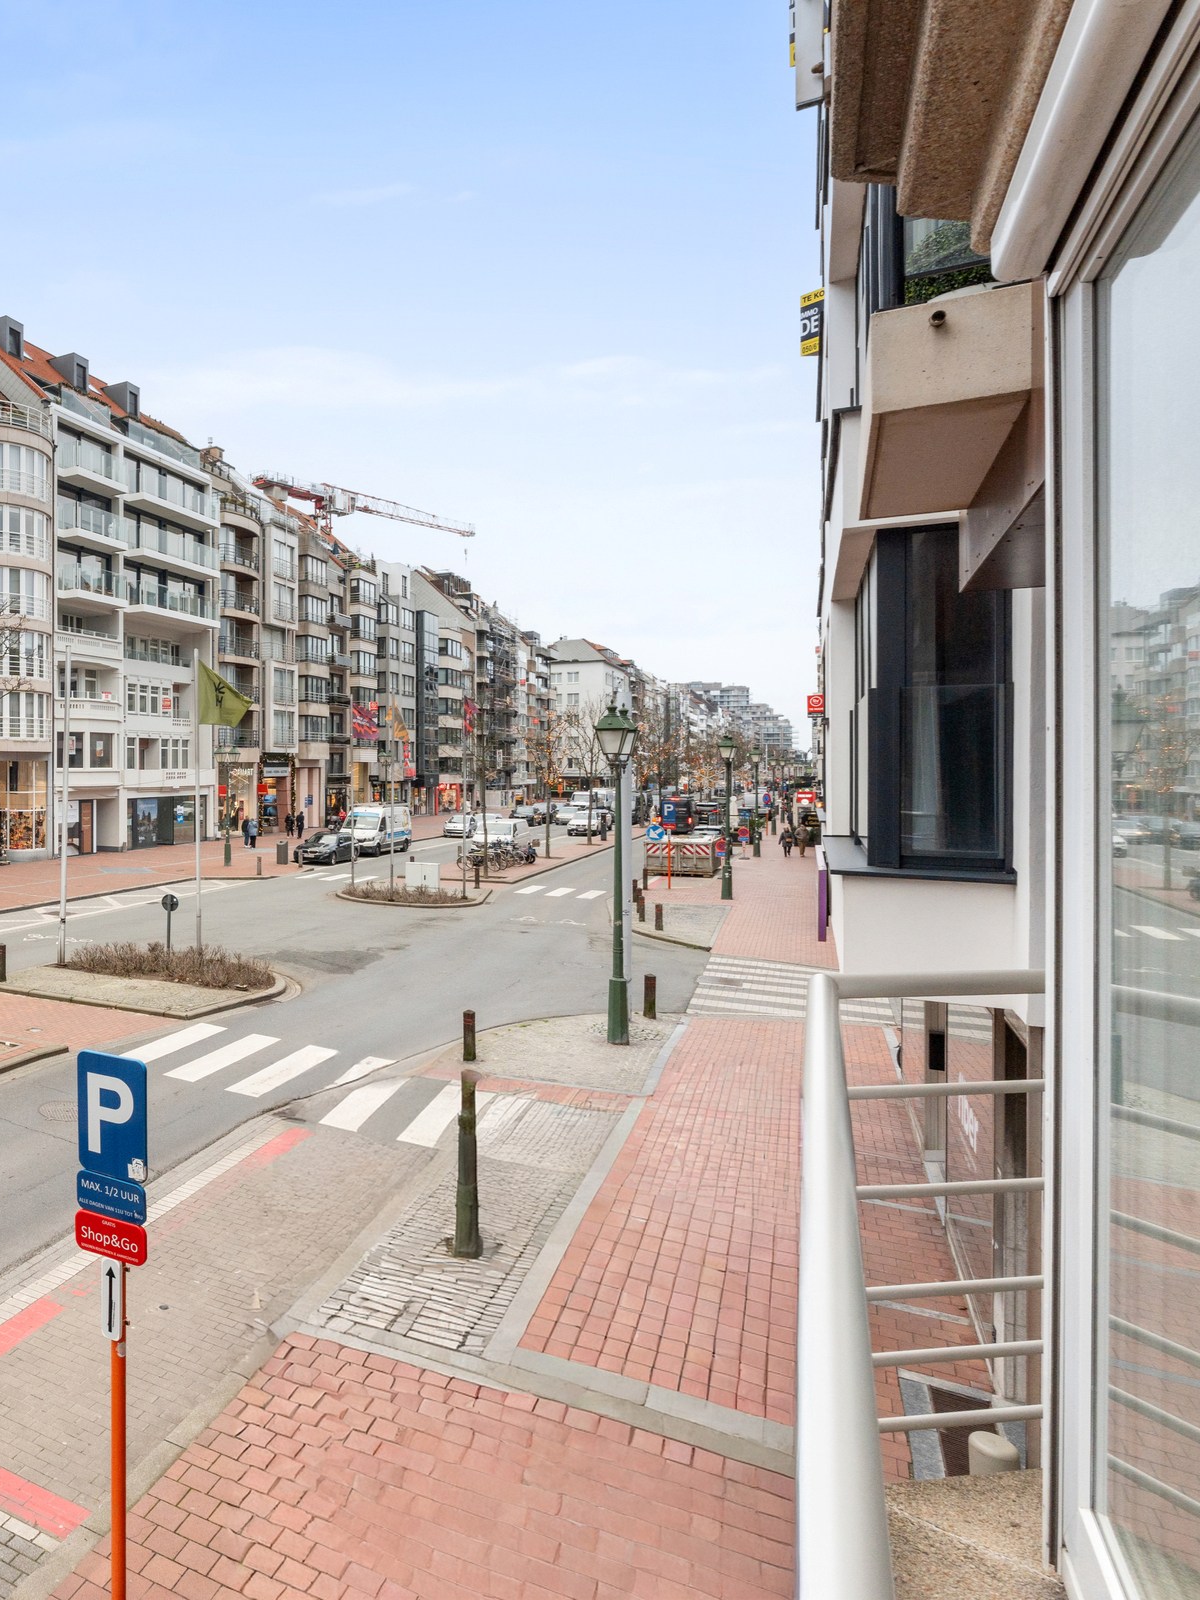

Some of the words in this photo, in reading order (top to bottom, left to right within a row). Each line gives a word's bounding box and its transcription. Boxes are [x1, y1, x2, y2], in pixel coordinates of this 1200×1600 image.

[802, 294, 813, 303] TE
[663, 803, 674, 816] P
[86, 1071, 135, 1154] P
[81, 1178, 103, 1194] MAX.
[104, 1185, 119, 1198] 1/2
[120, 1189, 140, 1204] UUR
[79, 1197, 89, 1205] ALLE
[88, 1199, 105, 1209] DAGEN
[104, 1204, 115, 1212] VAN
[101, 1219, 117, 1228] GRATIS
[80, 1225, 139, 1254] Shop&Go
